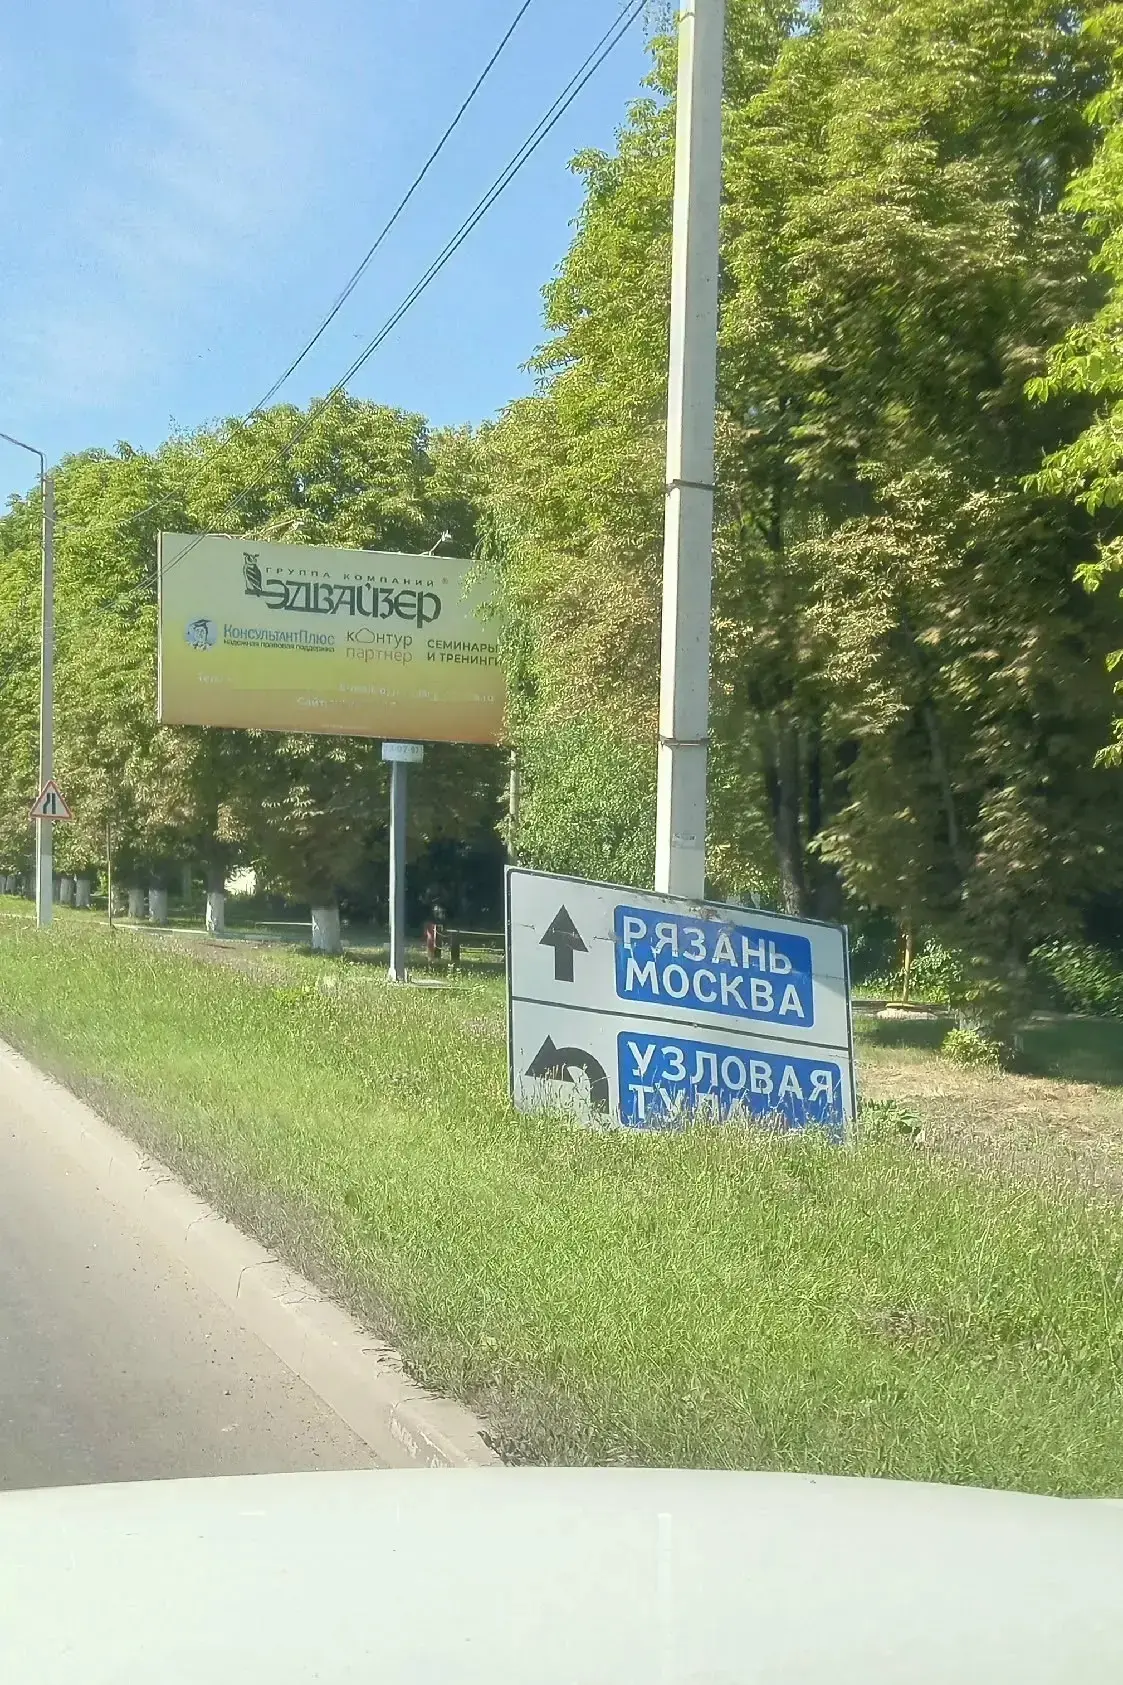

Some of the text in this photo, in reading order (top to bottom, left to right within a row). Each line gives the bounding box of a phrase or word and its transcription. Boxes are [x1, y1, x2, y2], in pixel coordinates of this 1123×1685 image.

[266, 567, 435, 588] ГРУППА КОМПАНИЙ
[427, 638, 500, 653] СЕМИНАРЫ
[346, 647, 413, 666] партнер
[427, 652, 436, 662] И
[622, 915, 793, 976] РЯЗАНЬ
[624, 957, 805, 1019] МОСКВА
[627, 1040, 833, 1104] УЗЛОВАЯ
